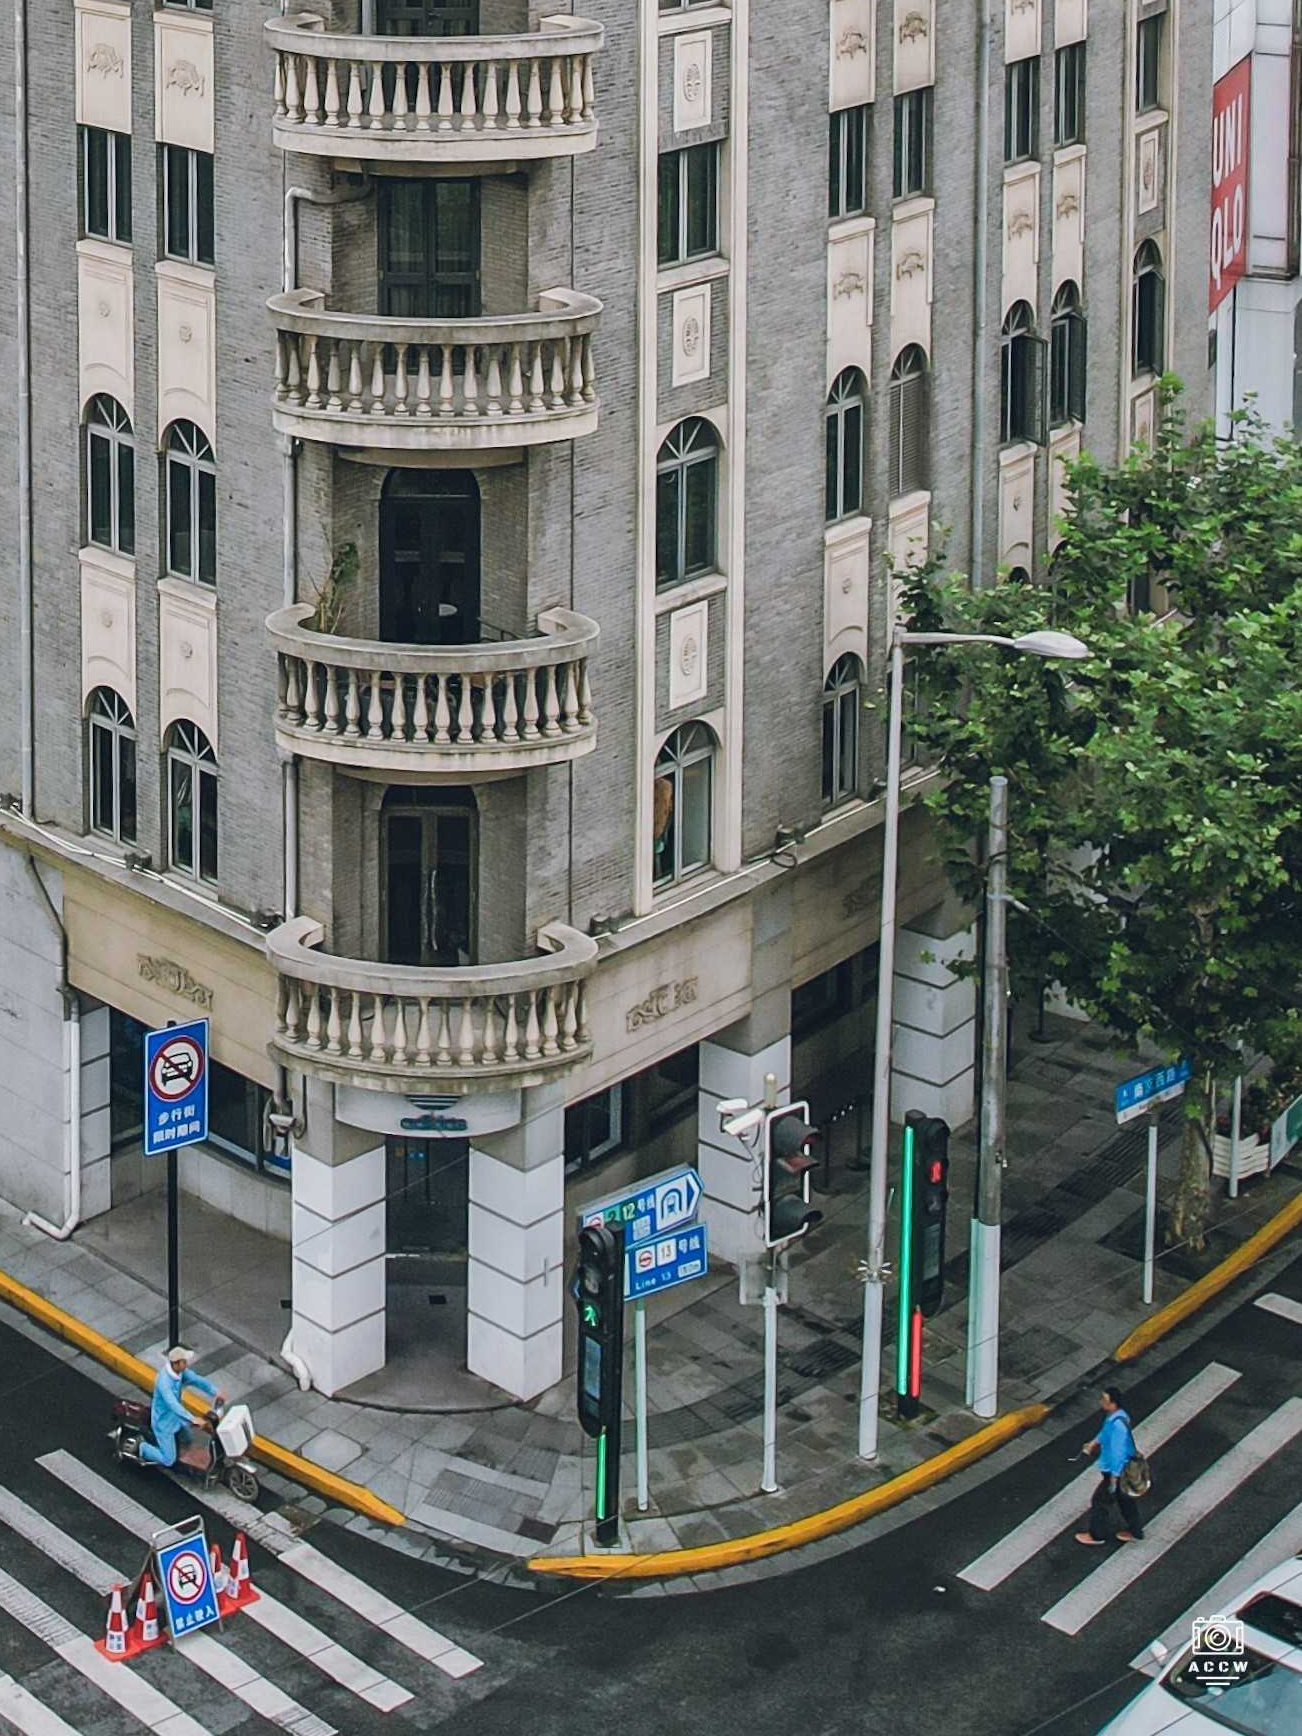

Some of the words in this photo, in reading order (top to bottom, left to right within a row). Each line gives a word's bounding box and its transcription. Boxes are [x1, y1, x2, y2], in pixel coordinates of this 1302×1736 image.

[1211, 92, 1243, 189] UNI
[1210, 183, 1243, 291] QLO
[622, 1203, 635, 1220] 12
[662, 1244, 672, 1260] 13
[636, 1275, 656, 1290] Line
[661, 1272, 672, 1281] 13
